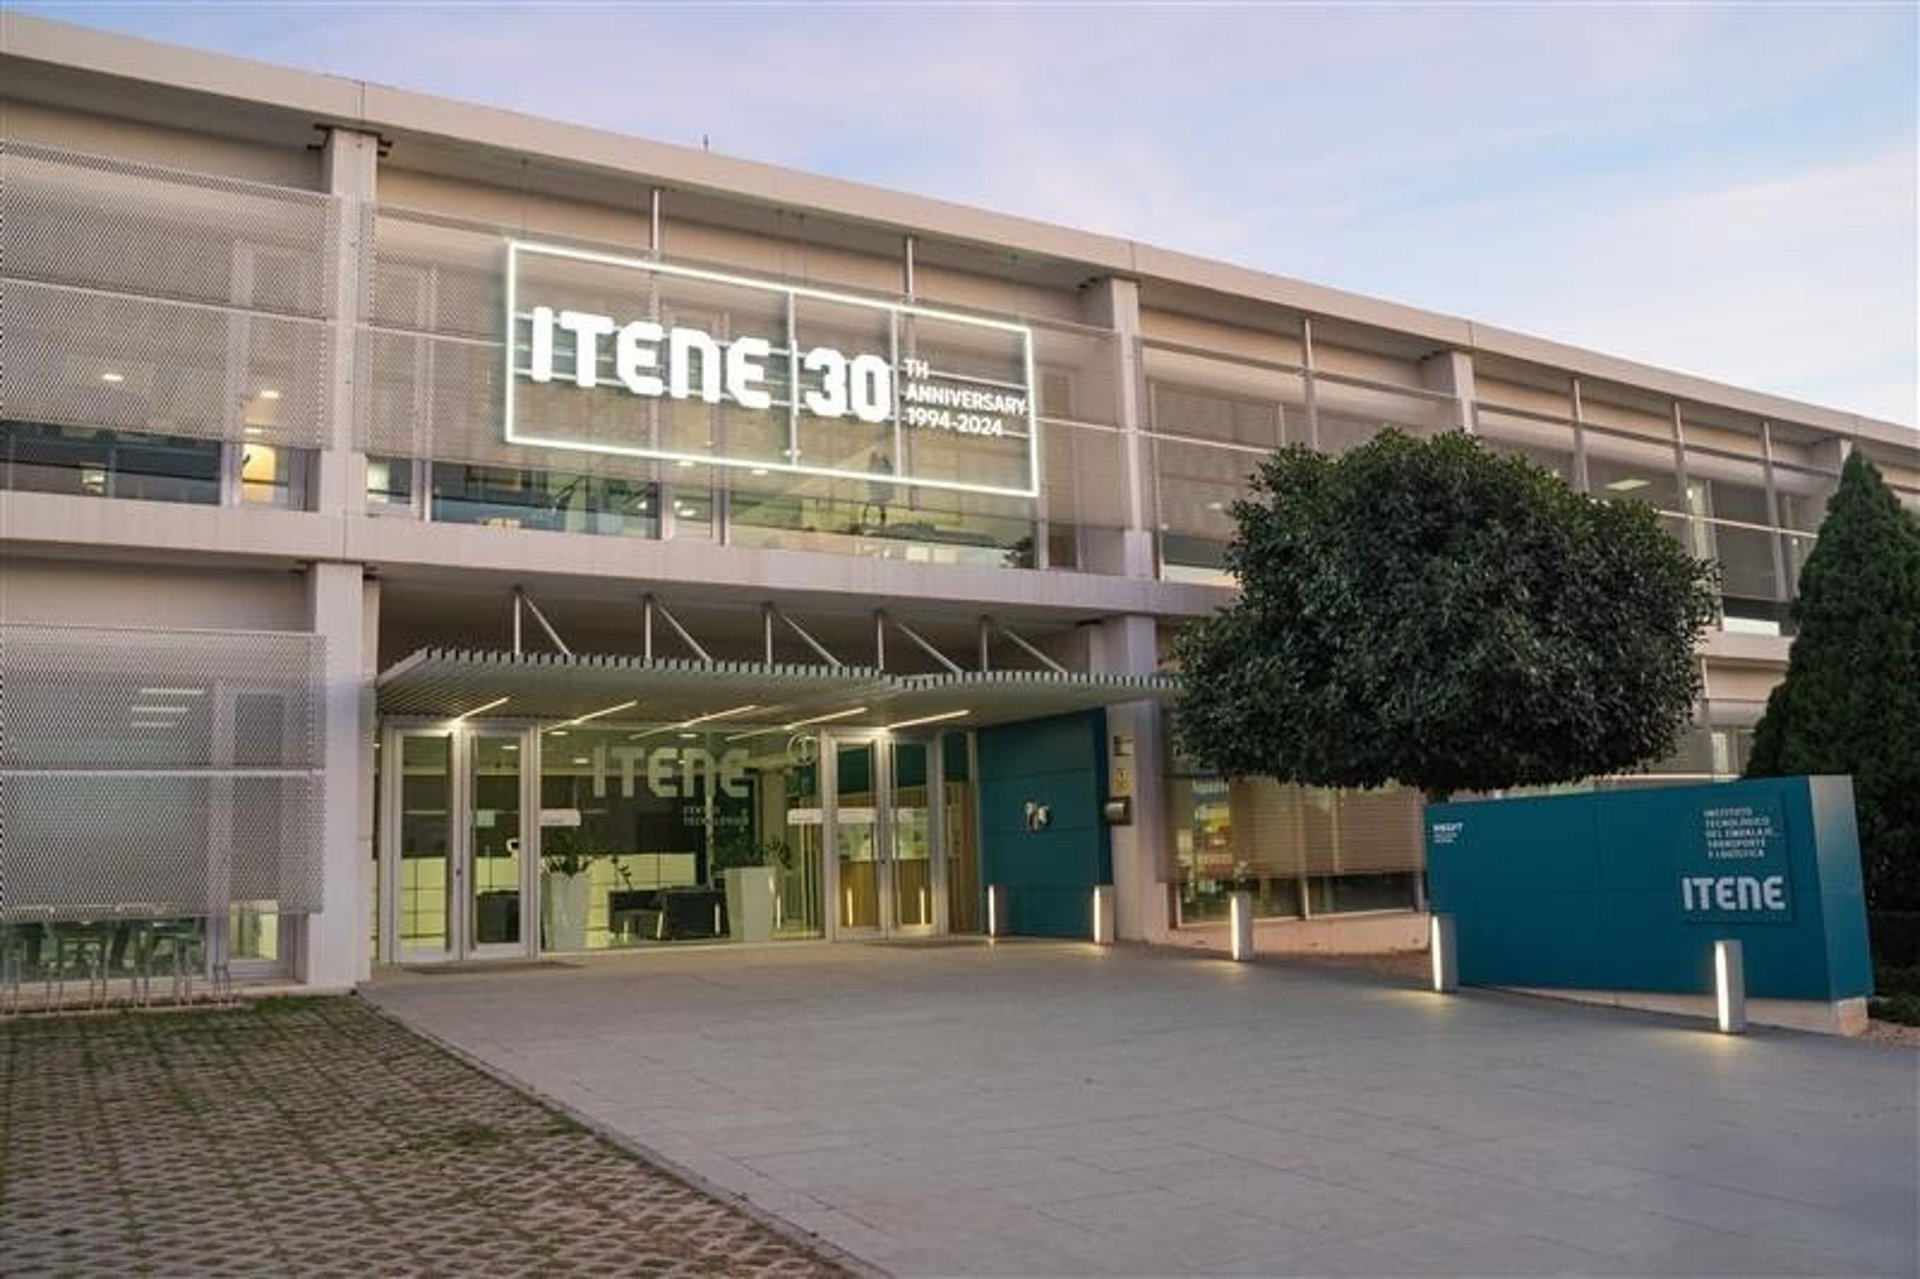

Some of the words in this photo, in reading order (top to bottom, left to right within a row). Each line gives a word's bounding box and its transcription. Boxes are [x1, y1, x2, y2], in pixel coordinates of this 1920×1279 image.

[531, 306, 771, 409] ITENE
[805, 347, 890, 423] 30
[904, 357, 929, 380] TH
[906, 383, 1026, 415] ANNIVERSARY
[906, 406, 1002, 436] 1994-2024
[593, 748, 749, 798] ITENE
[1682, 875, 1785, 910] ITENE
